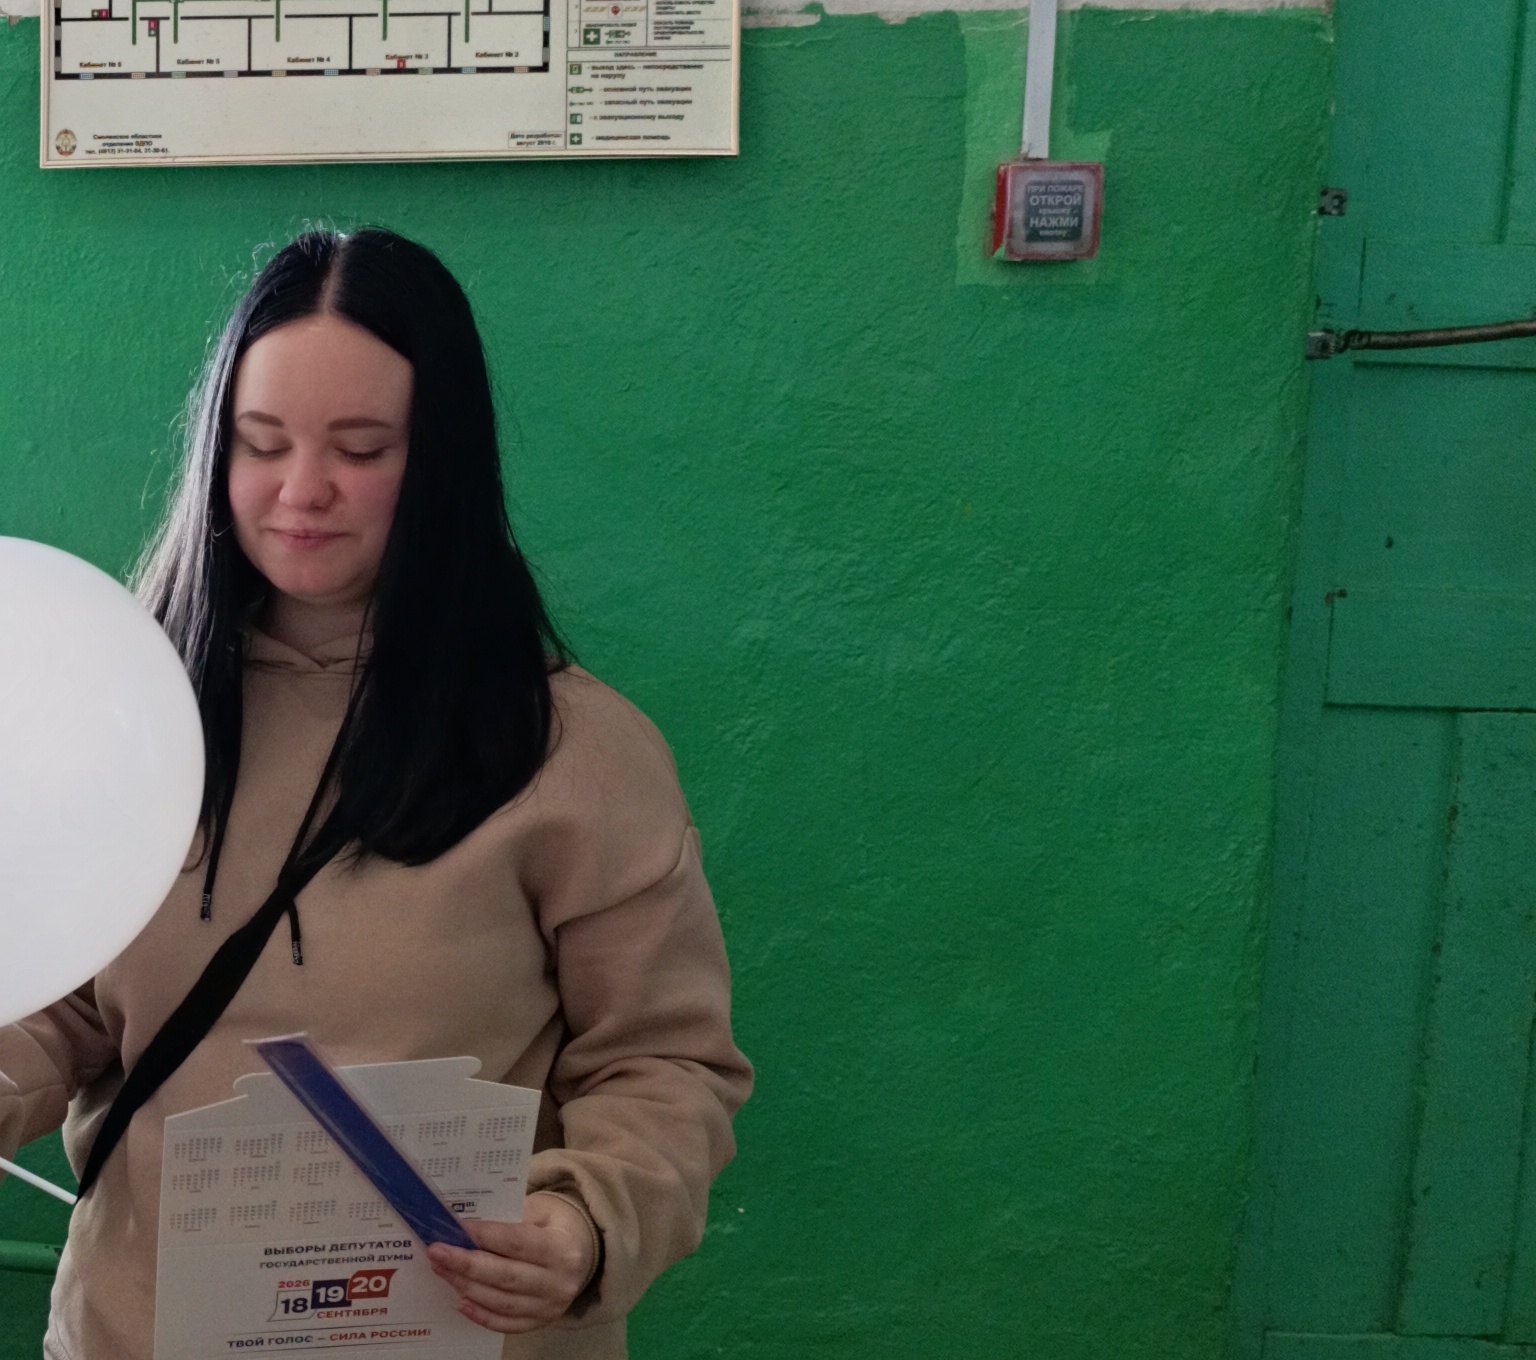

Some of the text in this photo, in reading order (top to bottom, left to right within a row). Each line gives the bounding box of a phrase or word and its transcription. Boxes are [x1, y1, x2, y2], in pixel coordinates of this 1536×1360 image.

[1029, 193, 1082, 206] ОТКРОЙ
[1029, 217, 1079, 228] НАЖМИ
[264, 1240, 412, 1256] ВЫБОРЫ ДЕПУТАТОВ
[259, 1254, 414, 1269] ГОСУДАРСТВЕННОЙ ДУМЫ
[278, 1280, 310, 1289] 2026
[351, 1275, 387, 1293] 20
[315, 1286, 345, 1303] 19
[280, 1297, 309, 1314] 18
[316, 1308, 388, 1319] СЕНТЯБРЯ
[227, 1337, 264, 1349] ТВОЙ
[268, 1335, 314, 1346] ГОЛОС
[329, 1332, 367, 1341] СИЛА
